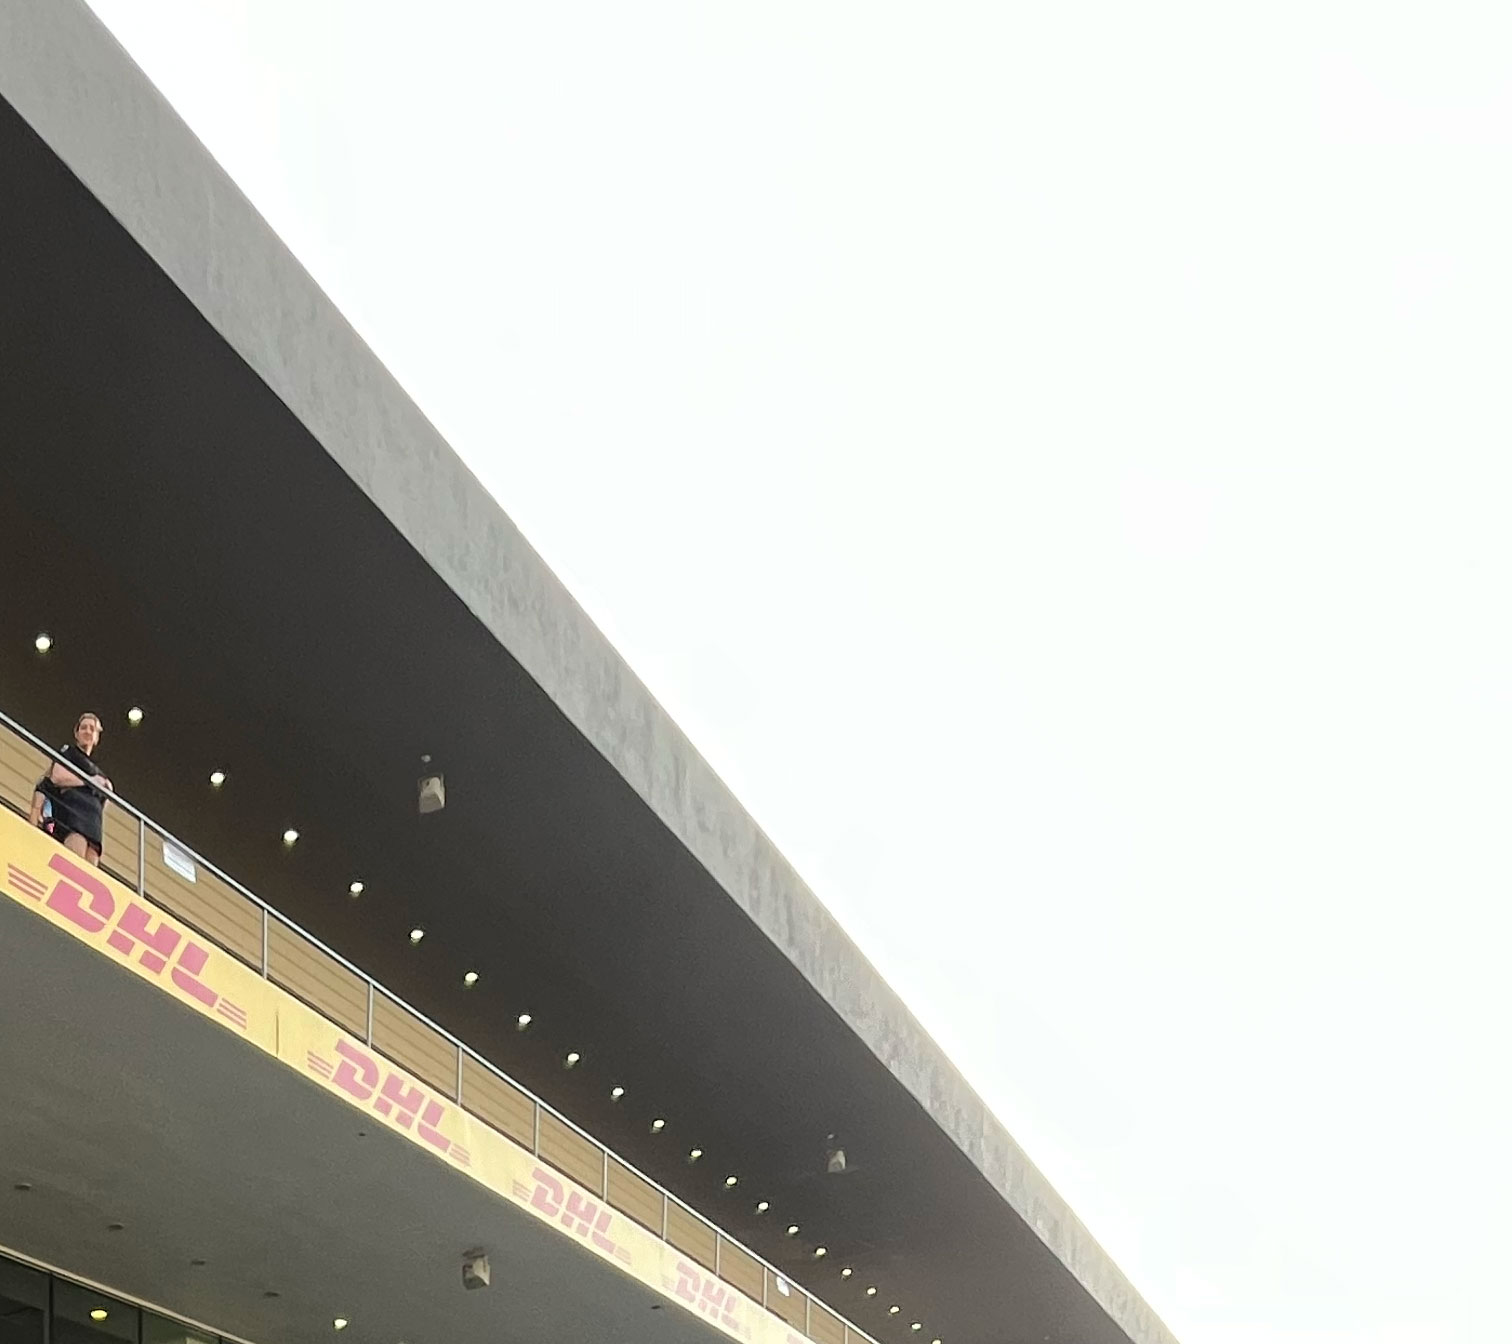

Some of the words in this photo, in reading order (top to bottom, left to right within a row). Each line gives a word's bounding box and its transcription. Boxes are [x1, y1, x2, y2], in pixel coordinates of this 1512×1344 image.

[45, 853, 219, 1008] DHL
[331, 1038, 451, 1154] DHL
[529, 1166, 617, 1255] DHL
[675, 1261, 740, 1331] DHL
